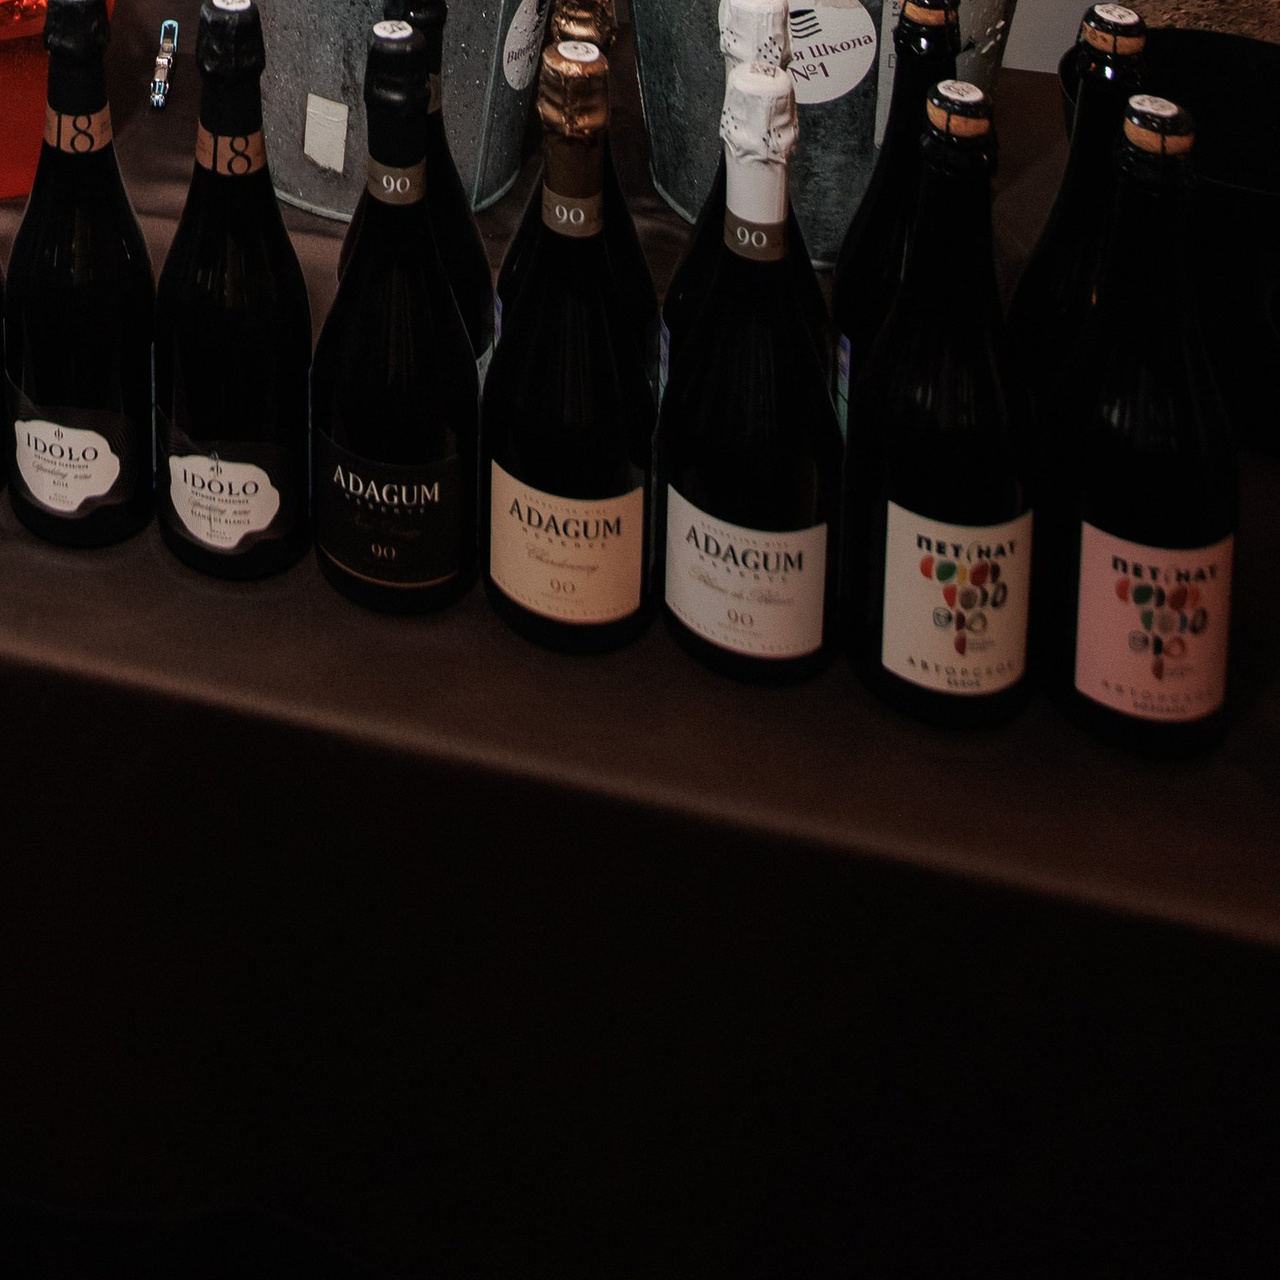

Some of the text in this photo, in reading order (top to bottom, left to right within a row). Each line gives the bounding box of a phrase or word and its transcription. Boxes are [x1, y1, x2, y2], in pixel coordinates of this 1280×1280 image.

[808, 34, 874, 59] Школа
[788, 62, 830, 84] №1
[57, 112, 95, 153] 18
[212, 136, 252, 175] 18
[382, 174, 410, 194] 90
[555, 204, 585, 225] 90
[736, 226, 767, 248] 90
[27, 432, 98, 461] IDOLO
[183, 468, 259, 496] IDOLO
[333, 464, 441, 506] ADAGUM
[509, 498, 622, 540] ADAGUM
[371, 543, 397, 560] 90
[686, 524, 802, 573] ADAGUM
[917, 533, 1016, 560] ПЕТ НАТ
[1112, 555, 1217, 582] ПЕТ НАТ
[550, 578, 576, 594] 90
[727, 608, 754, 625] 90
